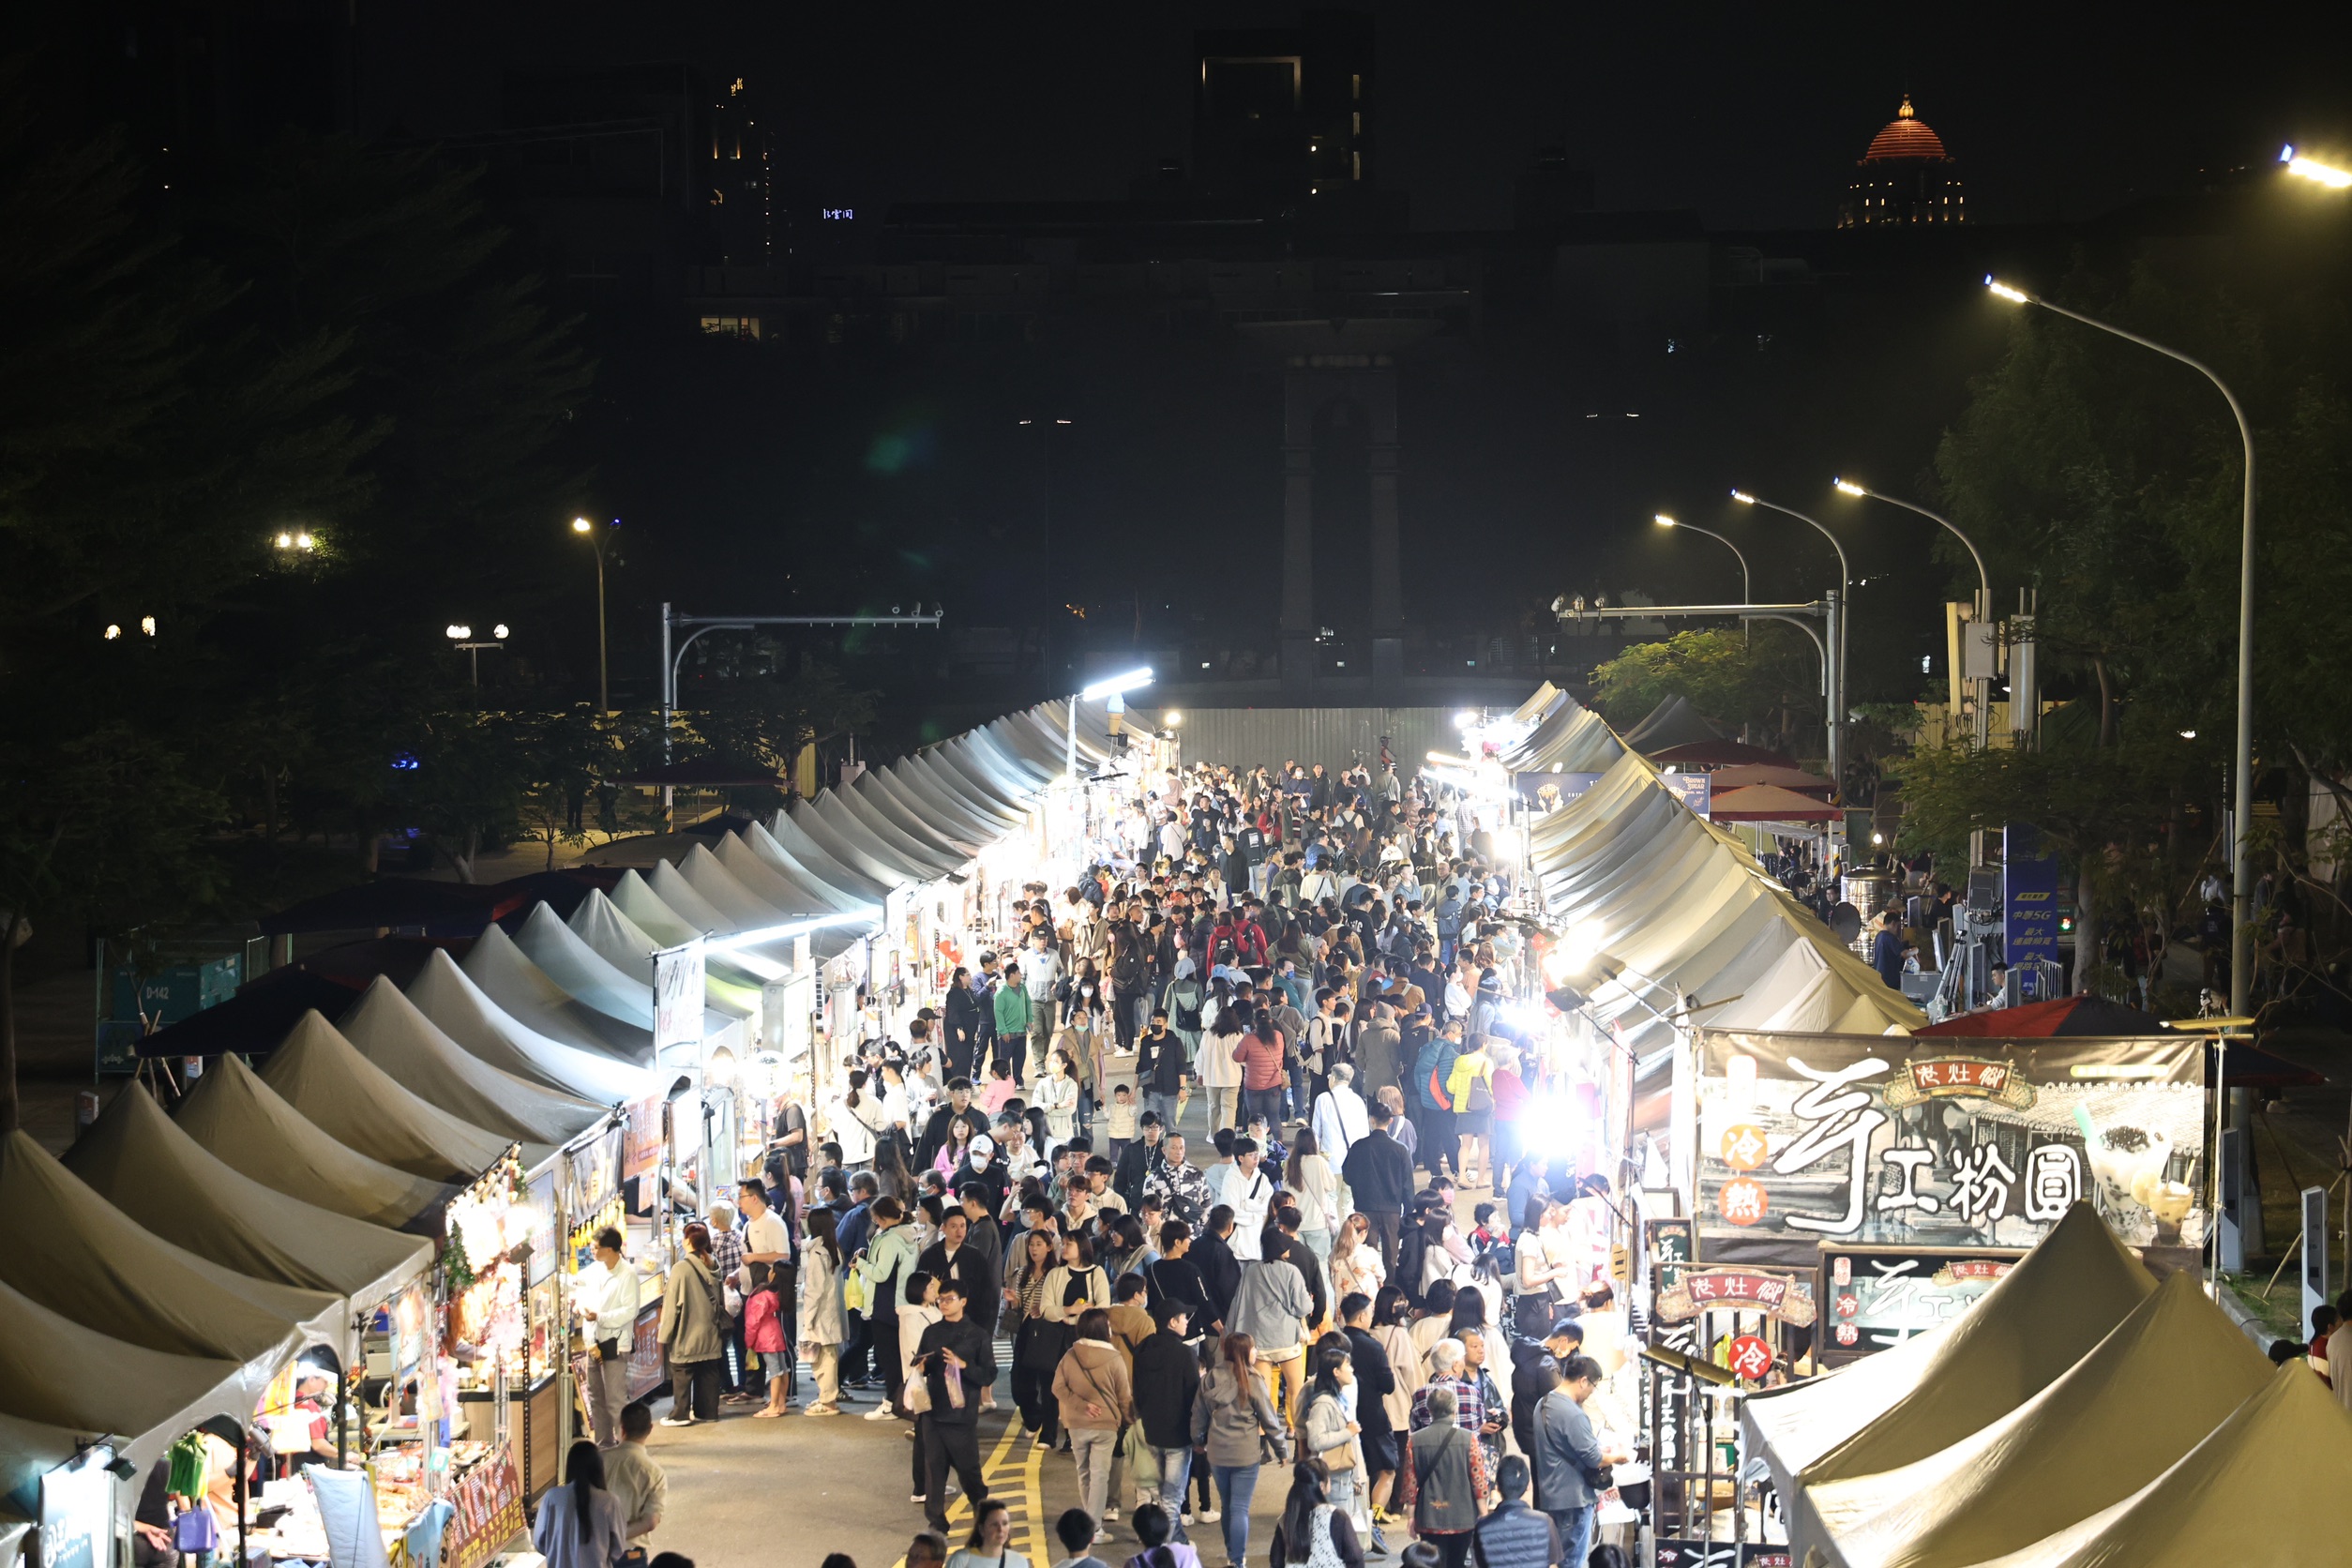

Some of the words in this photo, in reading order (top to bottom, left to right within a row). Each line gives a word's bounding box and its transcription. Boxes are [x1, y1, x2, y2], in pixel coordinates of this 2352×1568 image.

[1682, 776, 1706, 784] BROWN
[146, 987, 169, 1000] D-142
[1724, 1132, 1764, 1166] 冷
[1724, 1184, 1763, 1218] 熱
[1836, 1297, 1858, 1315] 冷
[1836, 1323, 1858, 1342] 熱
[1735, 1341, 1767, 1374] 冷
